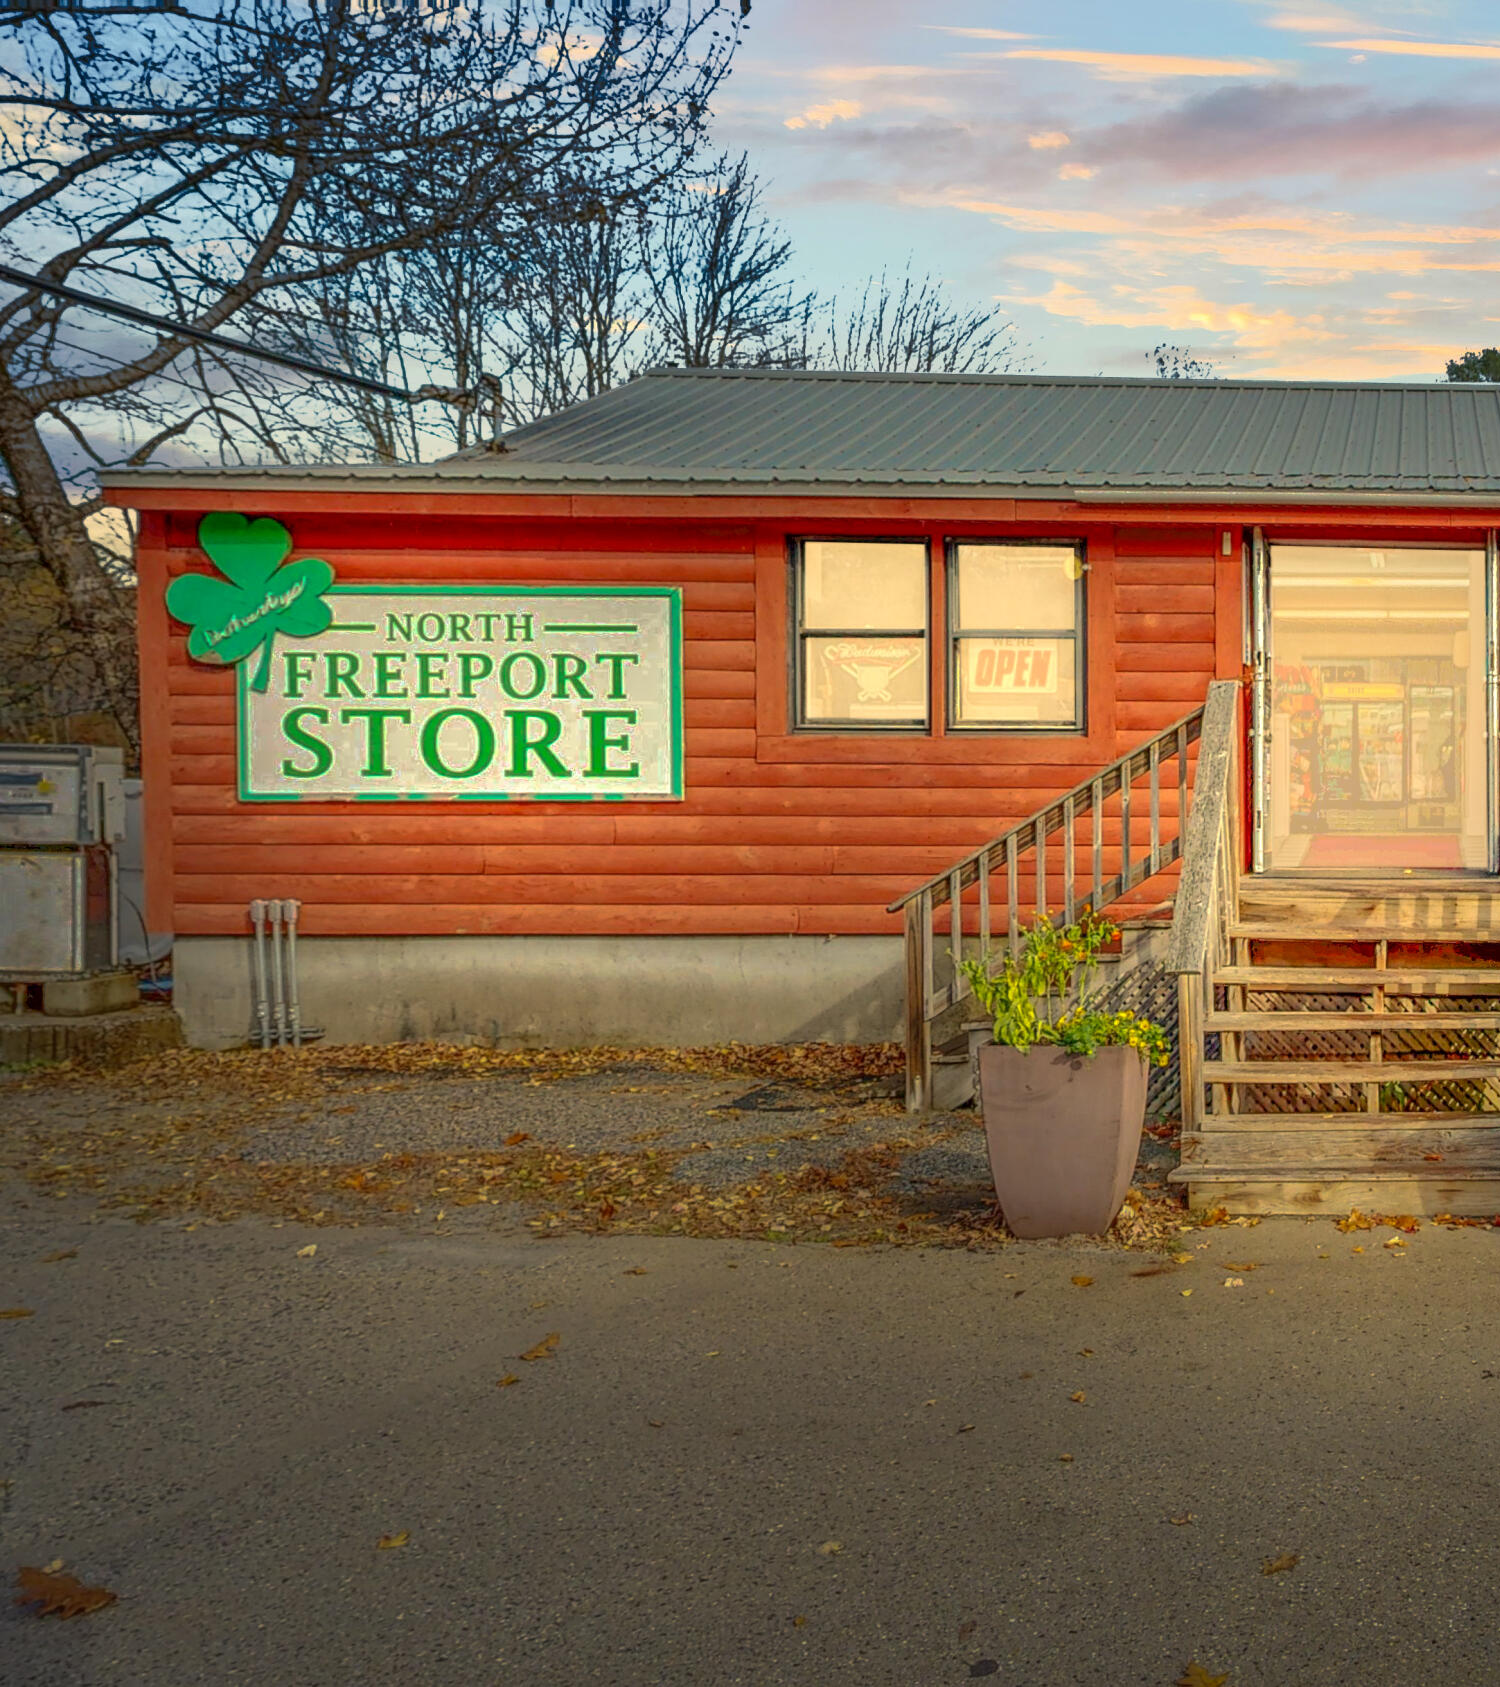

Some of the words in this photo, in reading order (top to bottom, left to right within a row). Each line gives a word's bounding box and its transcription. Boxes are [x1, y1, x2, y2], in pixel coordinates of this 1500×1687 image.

[386, 613, 534, 642] NORTH
[283, 651, 640, 700] FREEPORT
[975, 649, 1052, 687] OPEN
[282, 707, 641, 780] STORE
